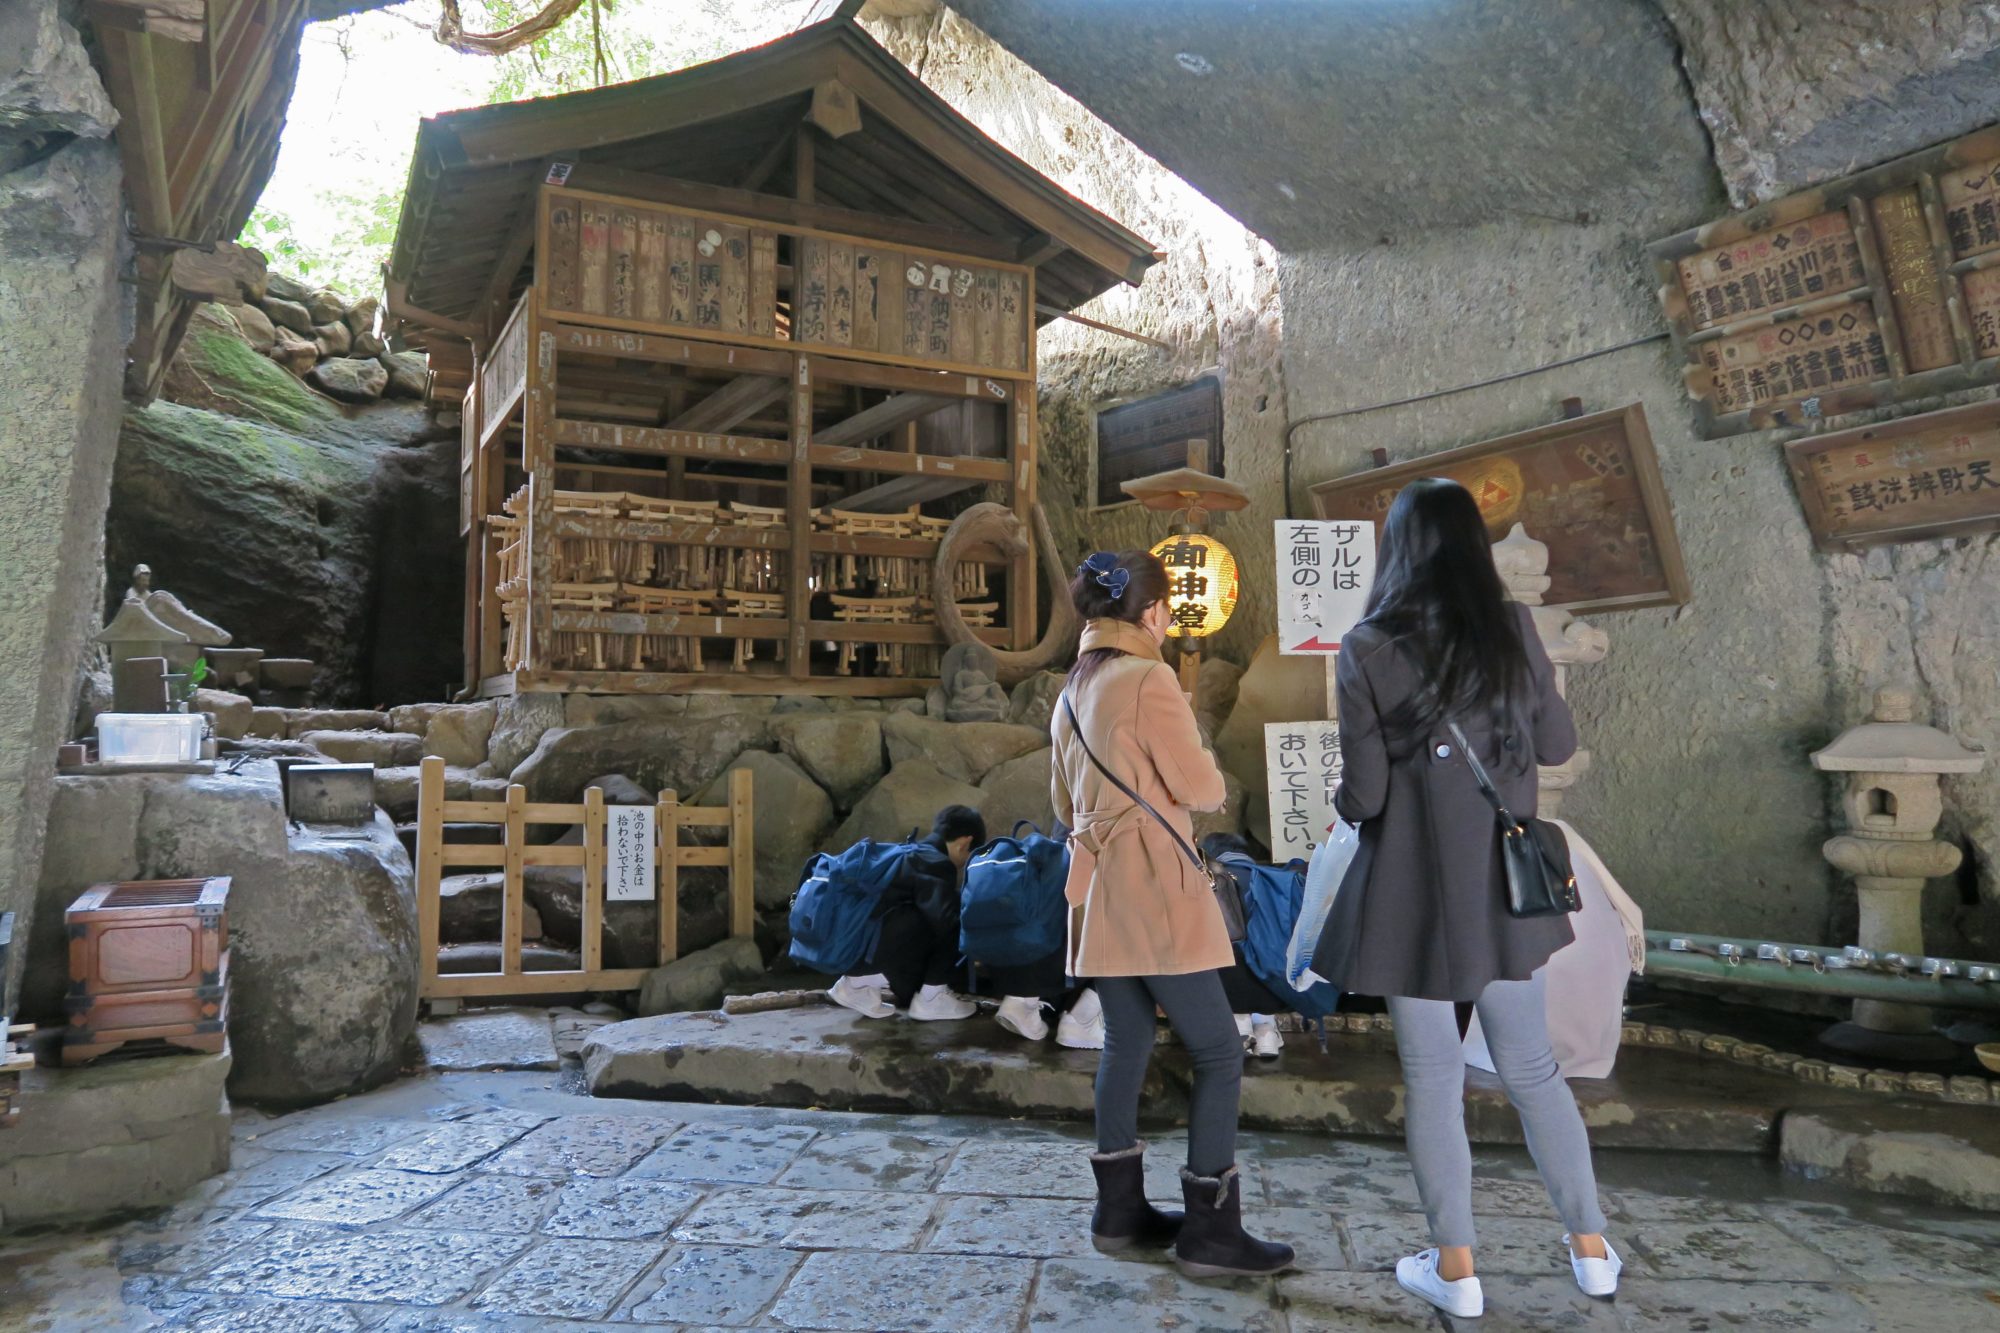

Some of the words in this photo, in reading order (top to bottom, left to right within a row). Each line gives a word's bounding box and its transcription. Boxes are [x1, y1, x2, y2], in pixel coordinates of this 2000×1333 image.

[1290, 524, 1321, 587] 左側の
[1330, 525, 1361, 590] ザルは
[1279, 733, 1317, 851] おいて下さい。
[617, 814, 629, 896] 拾わないで下さい
[633, 811, 646, 887] 池の中のお金は
